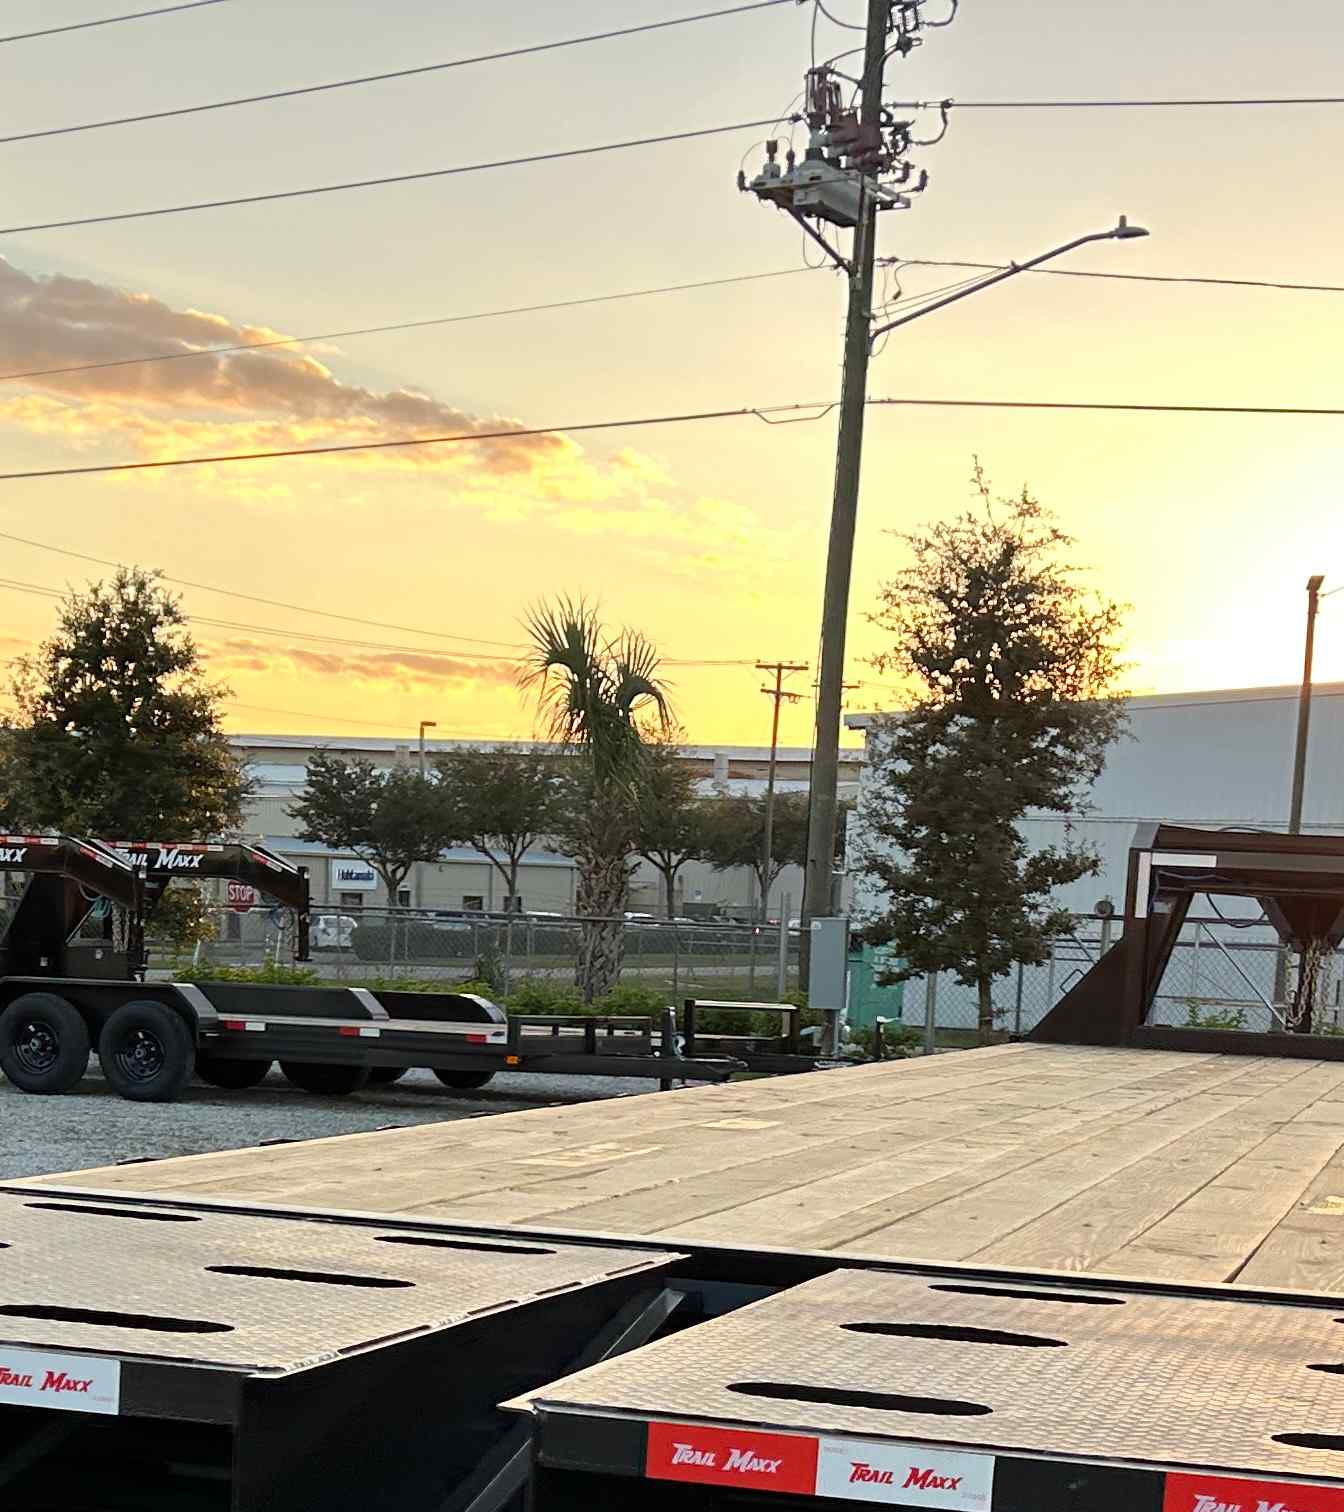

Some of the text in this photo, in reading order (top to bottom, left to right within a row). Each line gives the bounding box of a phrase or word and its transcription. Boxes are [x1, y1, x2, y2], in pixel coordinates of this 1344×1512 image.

[153, 848, 205, 870] MAXX
[229, 884, 253, 900] STOP
[40, 1370, 93, 1393] MAXX
[671, 1443, 783, 1474] TRAIL MAXX
[849, 1462, 964, 1491] TRAIL MAXX
